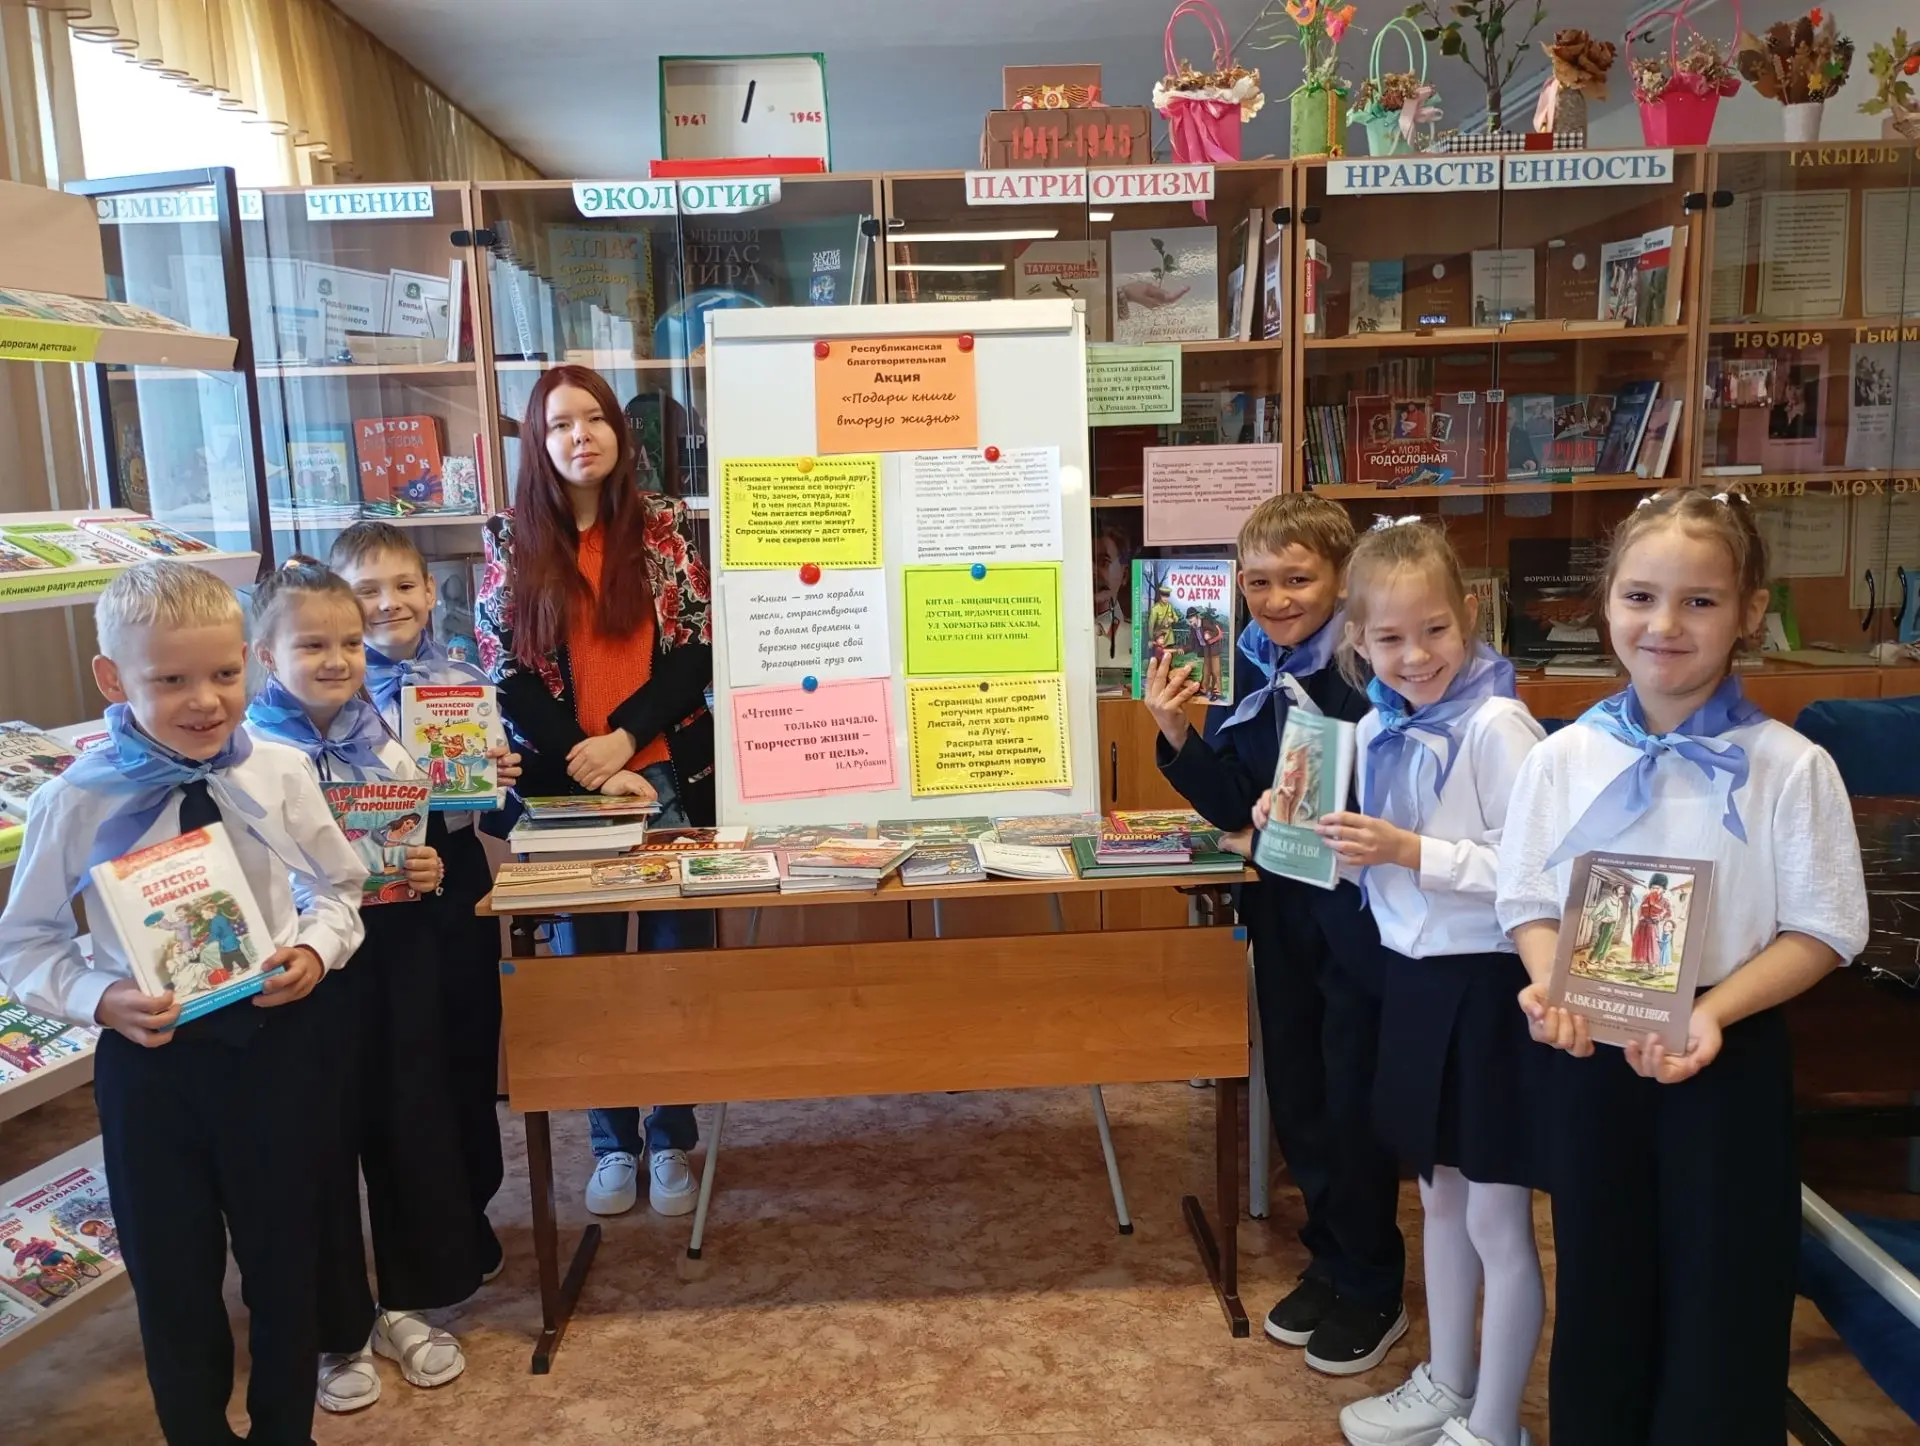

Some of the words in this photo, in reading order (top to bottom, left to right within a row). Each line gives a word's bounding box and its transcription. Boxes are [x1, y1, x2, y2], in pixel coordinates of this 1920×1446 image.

[674, 114, 706, 126] 1941
[790, 111, 822, 123] 1945
[972, 171, 1211, 199] ПАТРИОТИЗМ
[582, 183, 772, 211] ЭКОЛОГИЯ
[97, 192, 259, 219] СЕМЕЙНЕ
[309, 191, 431, 214] ЧТЕНИЕ
[0, 340, 38, 350] дорогам
[851, 343, 942, 354] Республиканская
[847, 356, 946, 366] благотворительная
[874, 372, 920, 384] Акция
[842, 391, 908, 405] «Подари
[912, 391, 956, 402] книге
[837, 414, 895, 428] вторую
[901, 414, 960, 427] жизнь»
[363, 420, 419, 437] АВТОР
[1399, 445, 1420, 454] МОЯ
[1371, 453, 1448, 467] РОДОСЛОВНАЯ
[1394, 466, 1419, 475] КНИГ
[813, 474, 846, 482] добрый
[814, 501, 850, 509] Маршак.
[810, 510, 851, 518] верблюд?
[825, 518, 855, 527] живут?
[735, 528, 777, 536] Спросишь
[1171, 574, 1226, 587] РАССКАЗЫ
[1, 585, 46, 597] «Книжная
[46, 581, 76, 594] радуга
[750, 594, 787, 603] «Книги
[826, 588, 864, 601] корабли
[1176, 588, 1185, 599] О
[1188, 587, 1221, 601] ДЕТЯХ
[749, 612, 784, 621] мысли,
[786, 605, 868, 619] странствующие
[774, 626, 808, 635] волнам
[811, 623, 851, 635] времени
[758, 644, 797, 655] бережно
[800, 641, 841, 651] несущие
[843, 637, 864, 647] свой
[761, 657, 821, 671] драгоценный
[824, 656, 845, 666] груз
[847, 655, 863, 663] от
[928, 698, 983, 708] «Страницы
[985, 696, 1008, 704] книг
[1011, 693, 1046, 702] сродни
[431, 709, 469, 717] ЧТЕНИЕ
[741, 706, 793, 719] «Чтение
[940, 708, 983, 718] могучим
[784, 719, 828, 732] только
[831, 714, 878, 726] начало.
[927, 718, 965, 729] Листай,
[968, 718, 991, 726] лети
[993, 716, 1015, 724] хоть
[1018, 714, 1049, 723] прямо
[982, 727, 1010, 737] Луну.
[744, 736, 818, 752] Творчество
[820, 731, 859, 743] жизни
[946, 738, 993, 748] Раскрыта
[996, 736, 1024, 745] книга
[804, 751, 826, 762] вот
[829, 747, 869, 760] цель».
[938, 749, 976, 759] значит,
[978, 748, 993, 756] мы
[996, 746, 1042, 756] открыли,
[936, 760, 966, 769] Опять
[968, 758, 1011, 768] открыли
[1013, 756, 1046, 765] новую
[969, 768, 1014, 779] страну».
[327, 784, 428, 803] ПРИНЦЕССА
[335, 801, 352, 812] НА
[355, 800, 416, 811] ГОРОШИНЕ
[1103, 833, 1162, 841] Пушкин
[141, 865, 207, 898] ДЕТСТВО
[149, 879, 210, 907] НИКИТЫ
[1564, 991, 1626, 1014] КАВКАЗСКИЙ
[1627, 1004, 1672, 1023] ПЛЕННИК
[26, 1174, 96, 1213] ХРЕСТОМАТИЯ
[86, 1188, 95, 1198] 2
